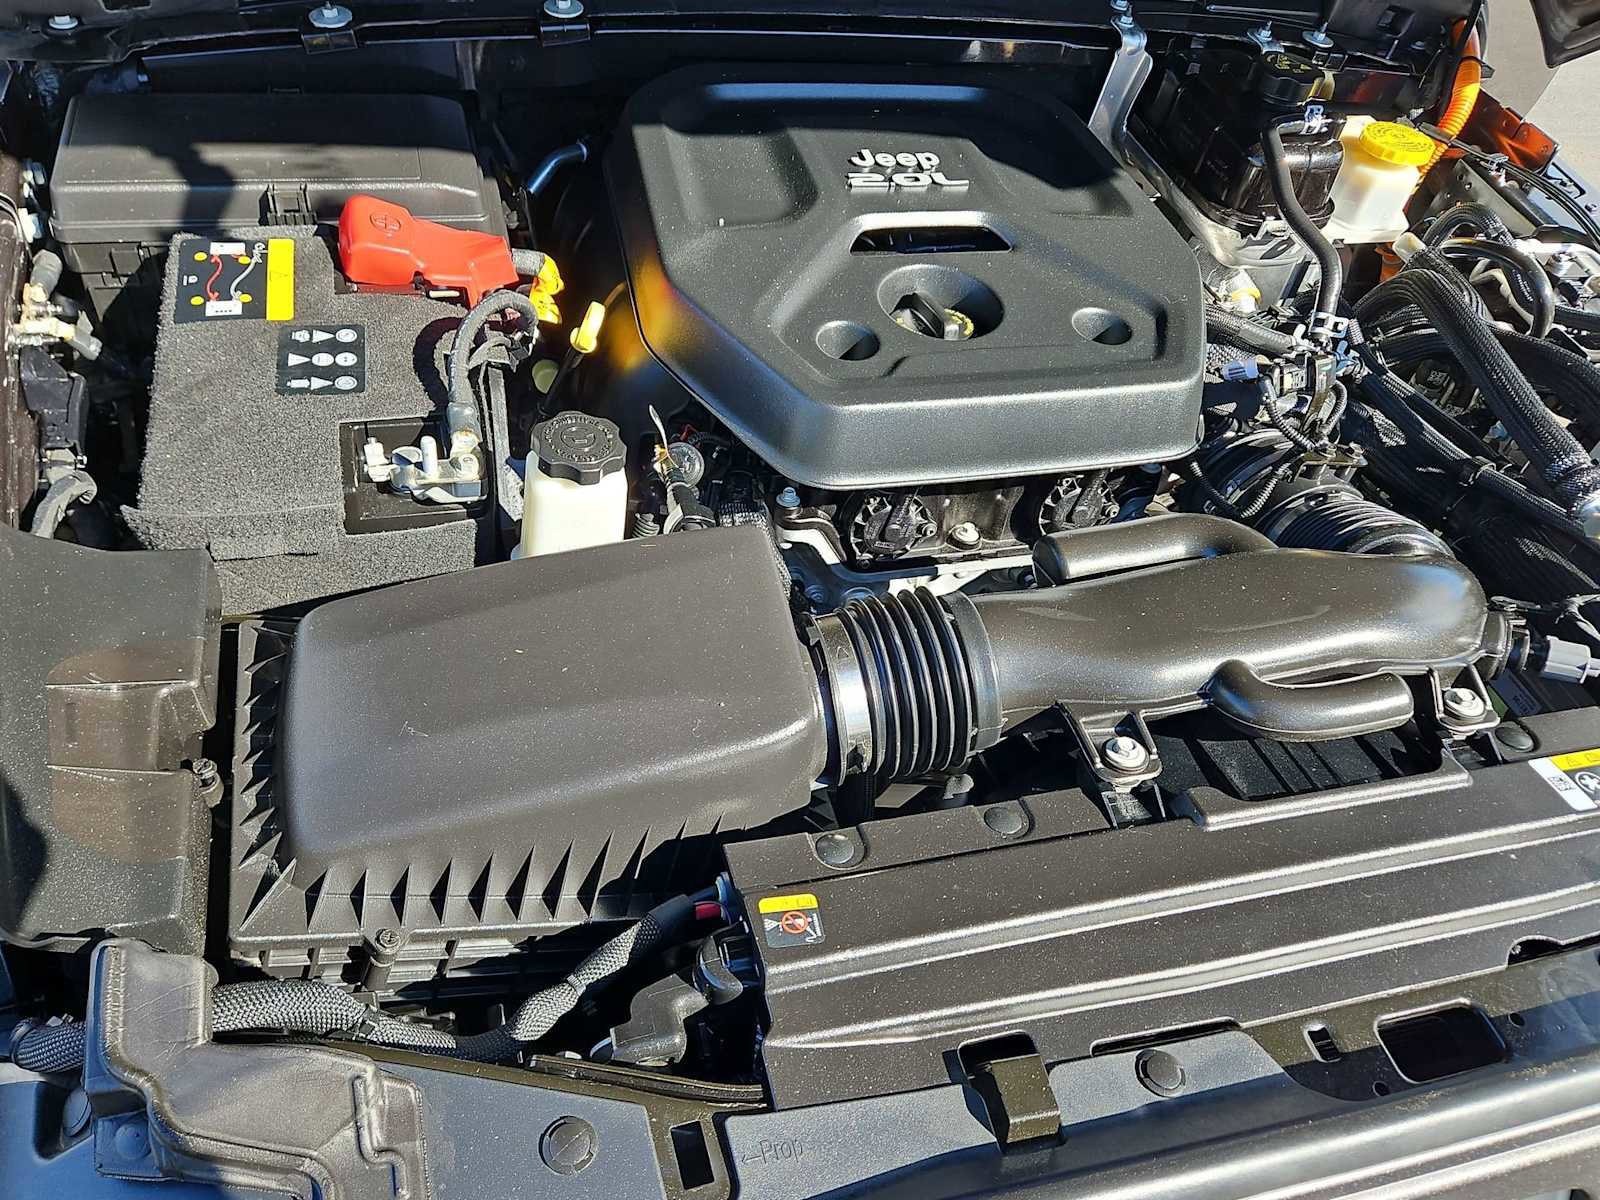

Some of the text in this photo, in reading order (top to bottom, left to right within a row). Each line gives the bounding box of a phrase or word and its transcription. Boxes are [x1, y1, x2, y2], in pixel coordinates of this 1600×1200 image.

[848, 148, 940, 172] Jeep
[846, 171, 970, 189] 2.0L
[759, 1138, 804, 1164] Prop
